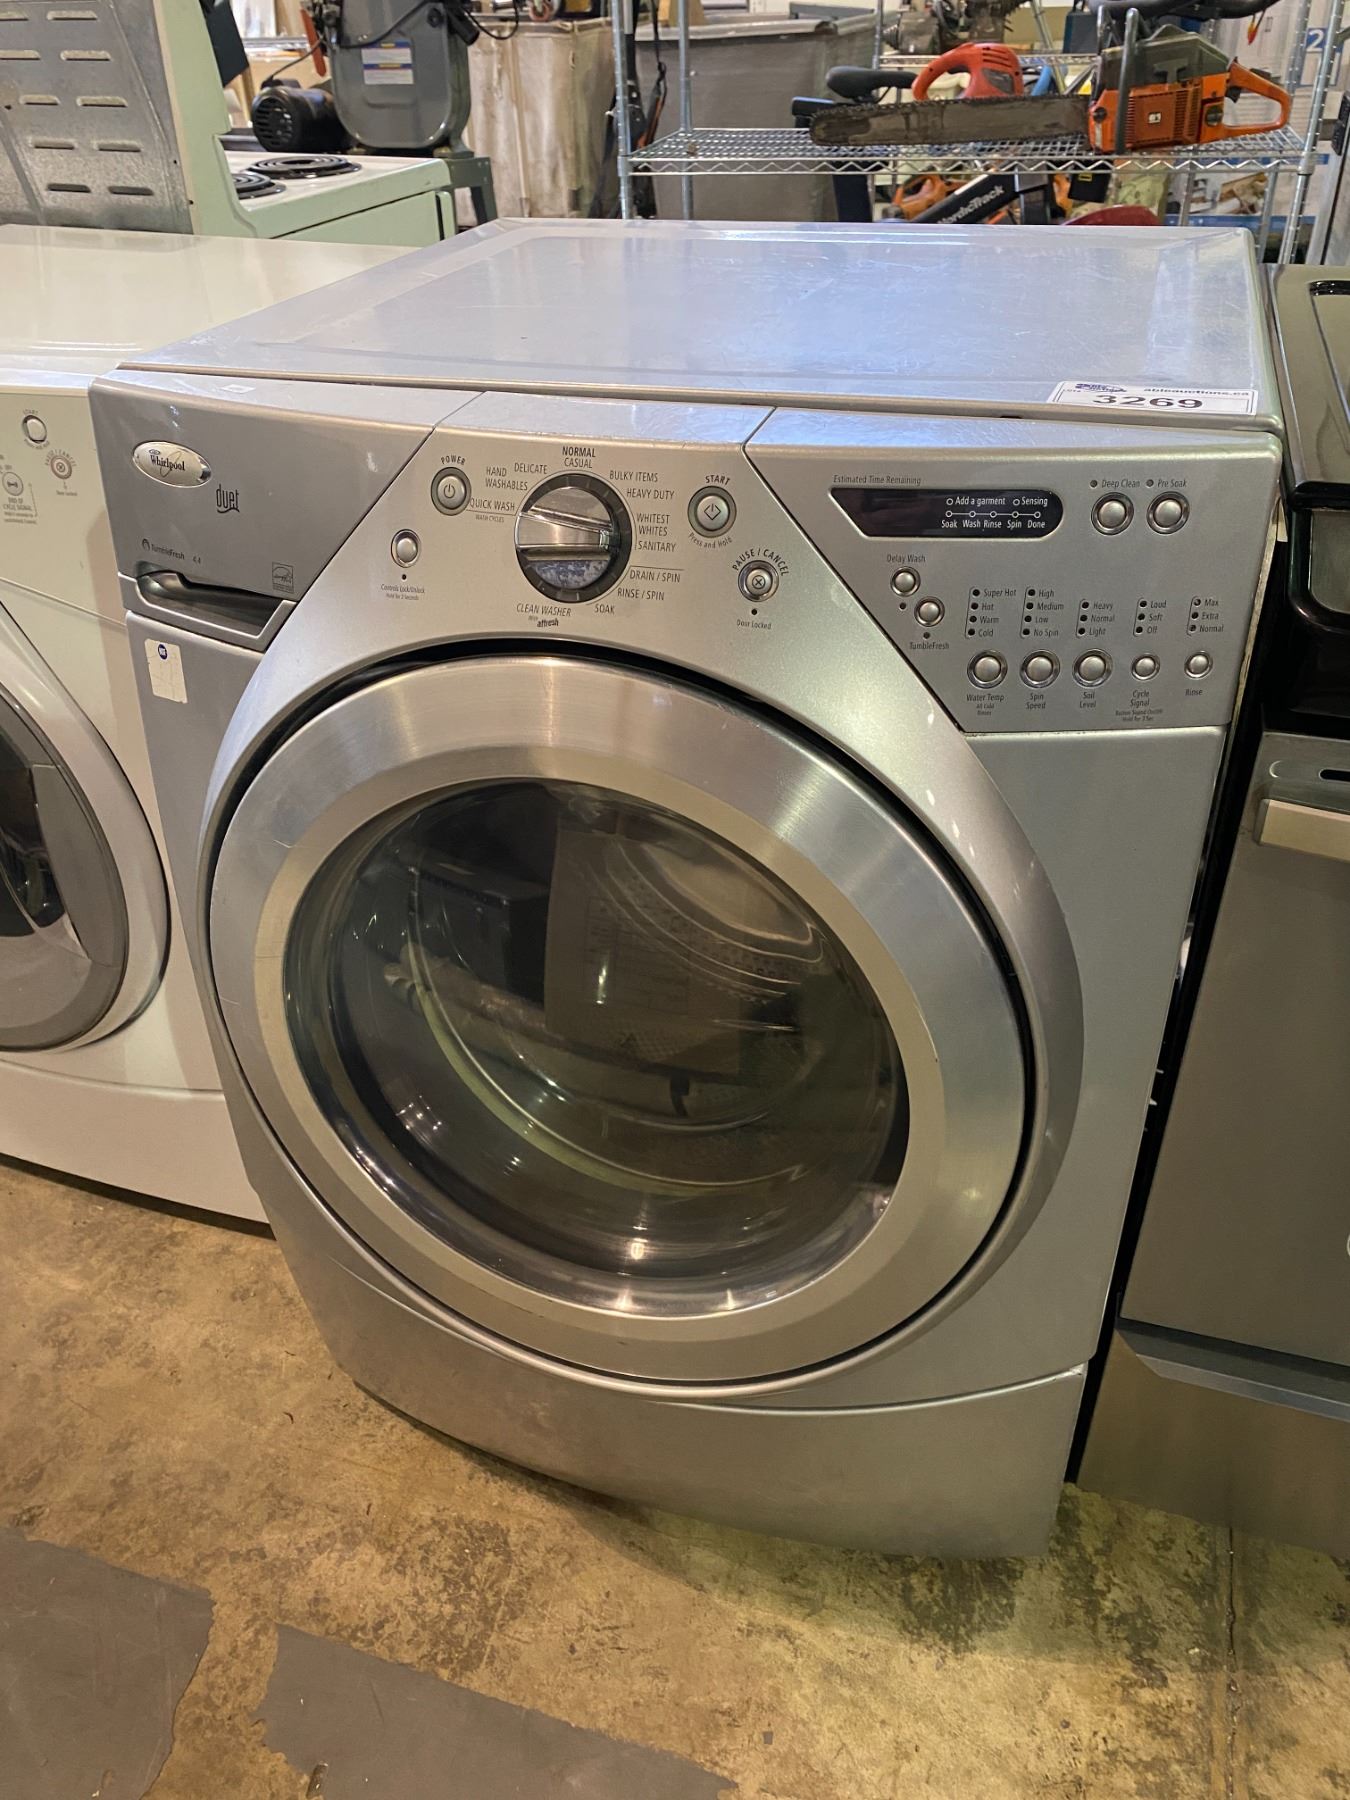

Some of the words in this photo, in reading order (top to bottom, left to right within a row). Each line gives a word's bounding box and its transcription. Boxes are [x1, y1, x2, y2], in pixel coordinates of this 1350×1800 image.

[1306, 29, 1325, 52] 2
[1093, 395, 1203, 409] 3269
[562, 446, 596, 458] NORMAL
[150, 455, 186, 471] Whirlpool
[441, 455, 466, 466] POWER
[564, 457, 593, 469] CASUAL
[486, 466, 507, 477] HAND
[514, 462, 548, 475] DELICATE
[609, 470, 634, 481] BULKY
[635, 471, 659, 483] ITEMS
[705, 474, 731, 486] START
[833, 475, 866, 484] Estimated
[868, 475, 885, 484] Time
[886, 476, 922, 486] Remaining
[485, 478, 528, 491] WASHABLES
[1101, 479, 1120, 490] Deep
[1121, 479, 1141, 488] Clean
[1157, 479, 1169, 488] Pre
[1170, 479, 1187, 488] Soak
[216, 484, 240, 510] duet
[627, 488, 651, 499] HEAVY
[653, 490, 675, 500] DUTY
[470, 498, 492, 510] QUICK
[494, 501, 515, 511] WASH
[955, 497, 970, 505] Add
[976, 497, 1006, 506] garment
[1021, 497, 1048, 507] Sensing
[637, 513, 670, 525] WHITEST
[941, 519, 958, 528] Soak
[962, 519, 981, 528] Wash
[983, 519, 1002, 528] Rinse
[1007, 519, 1022, 529] Spin
[1027, 519, 1046, 528] Done
[639, 525, 668, 537] WHITES
[688, 532, 703, 547] Press
[703, 541, 716, 549] and
[718, 536, 733, 547] Hold
[638, 541, 676, 552] SANITARY
[732, 548, 755, 571] PAUSE
[763, 548, 790, 576] CANCEL
[887, 554, 905, 564] Delay
[907, 554, 926, 563] Wash
[630, 569, 655, 581] DRAIN
[662, 572, 681, 583] SPIN
[617, 588, 640, 599] RINSE
[646, 591, 665, 601] SPIN
[983, 589, 1003, 598] Super
[1004, 588, 1017, 597] Hot
[1039, 589, 1055, 598] High
[982, 603, 994, 611] Hot
[1037, 603, 1065, 611] Medium
[1093, 602, 1114, 611] Heavy
[1150, 600, 1167, 609] Loud
[1204, 599, 1219, 607] Max
[516, 603, 539, 614] CLEAN
[541, 605, 572, 617] WASHER
[595, 603, 615, 615] SOAK
[980, 616, 1000, 624] Warm
[1035, 616, 1049, 624] Low
[1090, 614, 1116, 623] Normal
[1149, 613, 1164, 622] Soft
[1201, 612, 1219, 620] Extra
[736, 618, 750, 628] Door
[978, 629, 994, 637] Cold
[1034, 629, 1043, 637] No
[1045, 629, 1059, 638] Spin
[1089, 627, 1107, 637] Light
[1147, 626, 1158, 634] Off
[1200, 624, 1224, 633] Normal
[909, 641, 950, 650] TumbleFresh
[1083, 691, 1096, 700] Soil
[1132, 689, 1150, 699] Cycle
[1185, 687, 1204, 696] Rinse
[966, 693, 986, 702] Water
[987, 693, 1005, 703] Temp
[1030, 692, 1044, 702] Spin
[1026, 701, 1046, 710] Speed
[1080, 700, 1096, 709] Level
[1130, 699, 1150, 709] Signal
